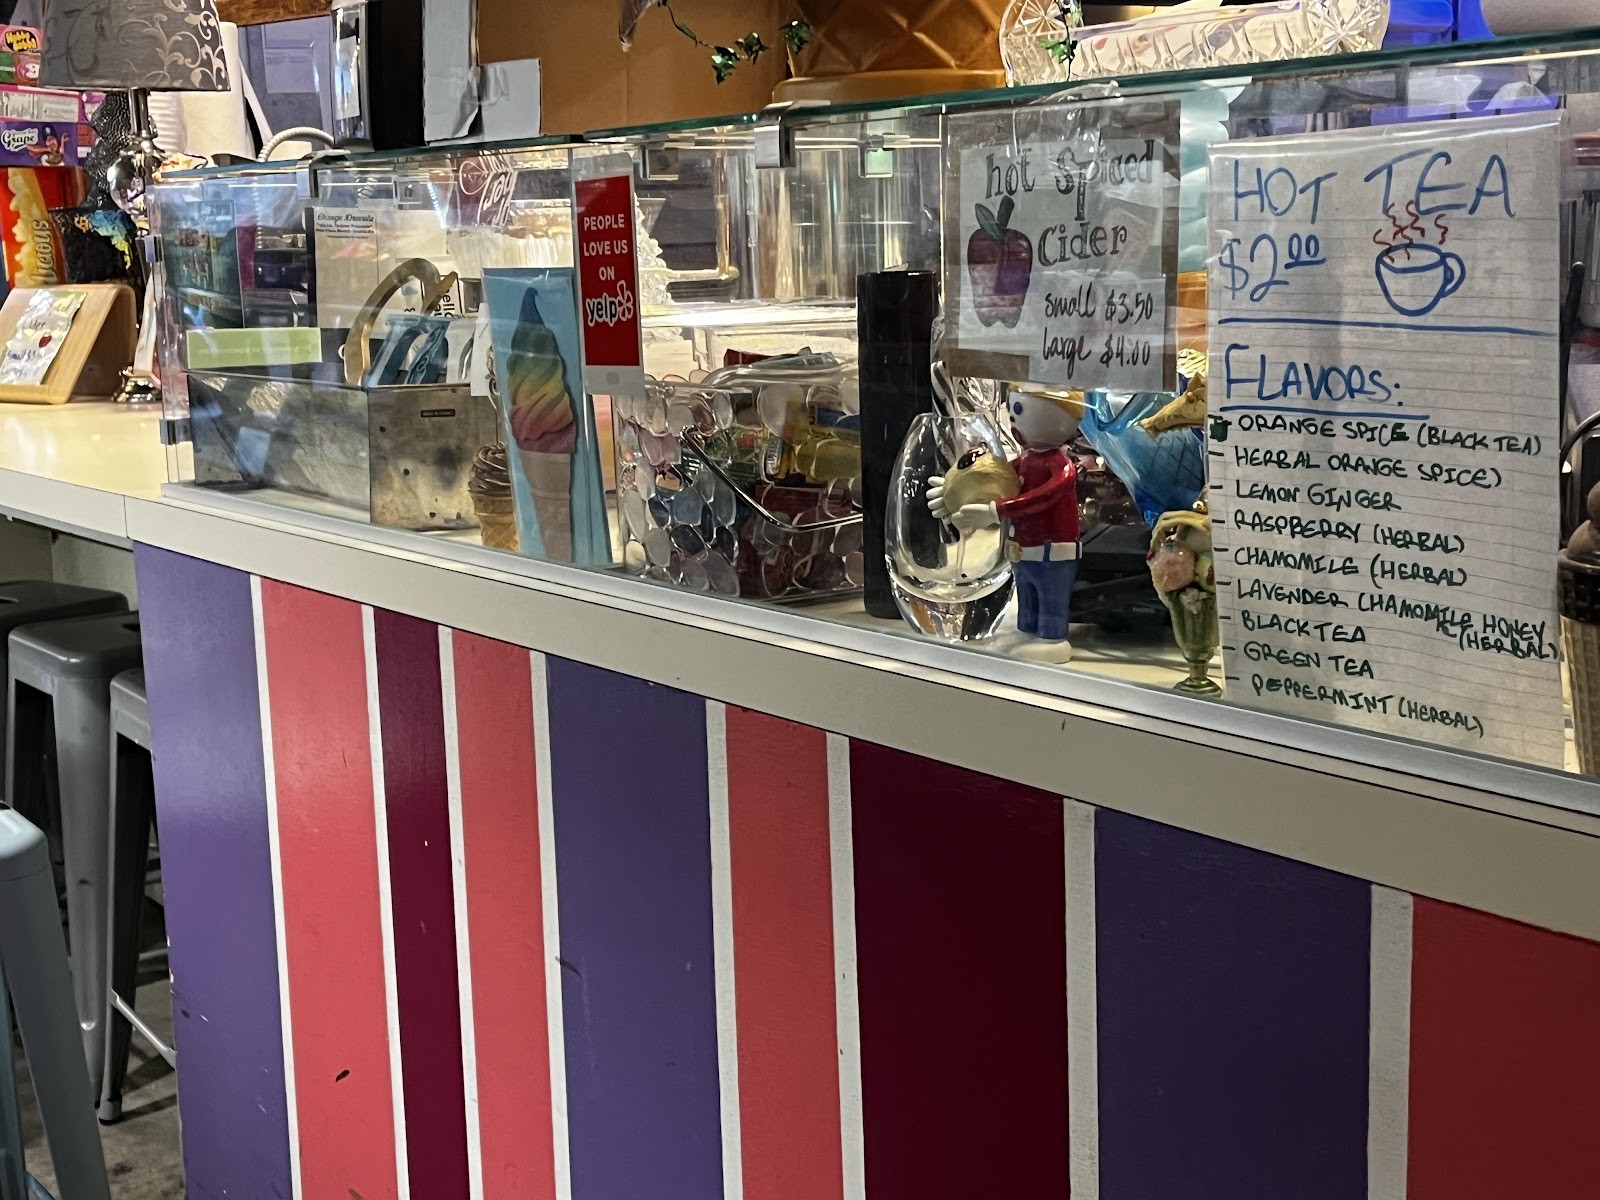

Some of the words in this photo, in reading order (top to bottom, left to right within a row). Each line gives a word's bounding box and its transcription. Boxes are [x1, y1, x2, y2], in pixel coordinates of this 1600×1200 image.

[2, 130, 35, 149] Grape
[985, 147, 1036, 199] hot
[1234, 159, 1338, 225] HOT
[1363, 148, 1516, 219] TEA
[583, 213, 625, 231] PEOPLE
[583, 240, 612, 257] LOVE
[613, 239, 629, 255] US
[1038, 222, 1127, 267] Cider
[598, 266, 615, 281] ON
[586, 294, 619, 326] yelp
[1105, 289, 1153, 325] $3.50
[1100, 333, 1151, 368] $4.00
[1225, 343, 1404, 407] FLAVORS:
[1238, 414, 1337, 438] ORANGE
[1343, 421, 1410, 447] SPICE
[1417, 422, 1489, 450] (BLACK
[1493, 435, 1542, 456] TEA)
[1234, 445, 1320, 470] HERBAL
[1327, 453, 1408, 479] ORANGE
[1418, 462, 1503, 489] SPICE)
[1236, 479, 1300, 503] LEMON
[1307, 482, 1402, 512] GINGER
[1234, 509, 1361, 544] RASPBERRY
[1373, 523, 1465, 553] (HERBAL)
[1234, 547, 1359, 575] CHAMOMILE
[1238, 578, 1349, 608] LAVENDER
[1483, 614, 1545, 644] HONEY
[1242, 610, 1310, 637] BLACK
[1314, 622, 1366, 643] TEA
[1244, 641, 1320, 668] GREEN
[1328, 655, 1374, 680] TEA
[1252, 673, 1394, 715] PEPPERMINT
[1398, 697, 1484, 738] (HERBAL)
